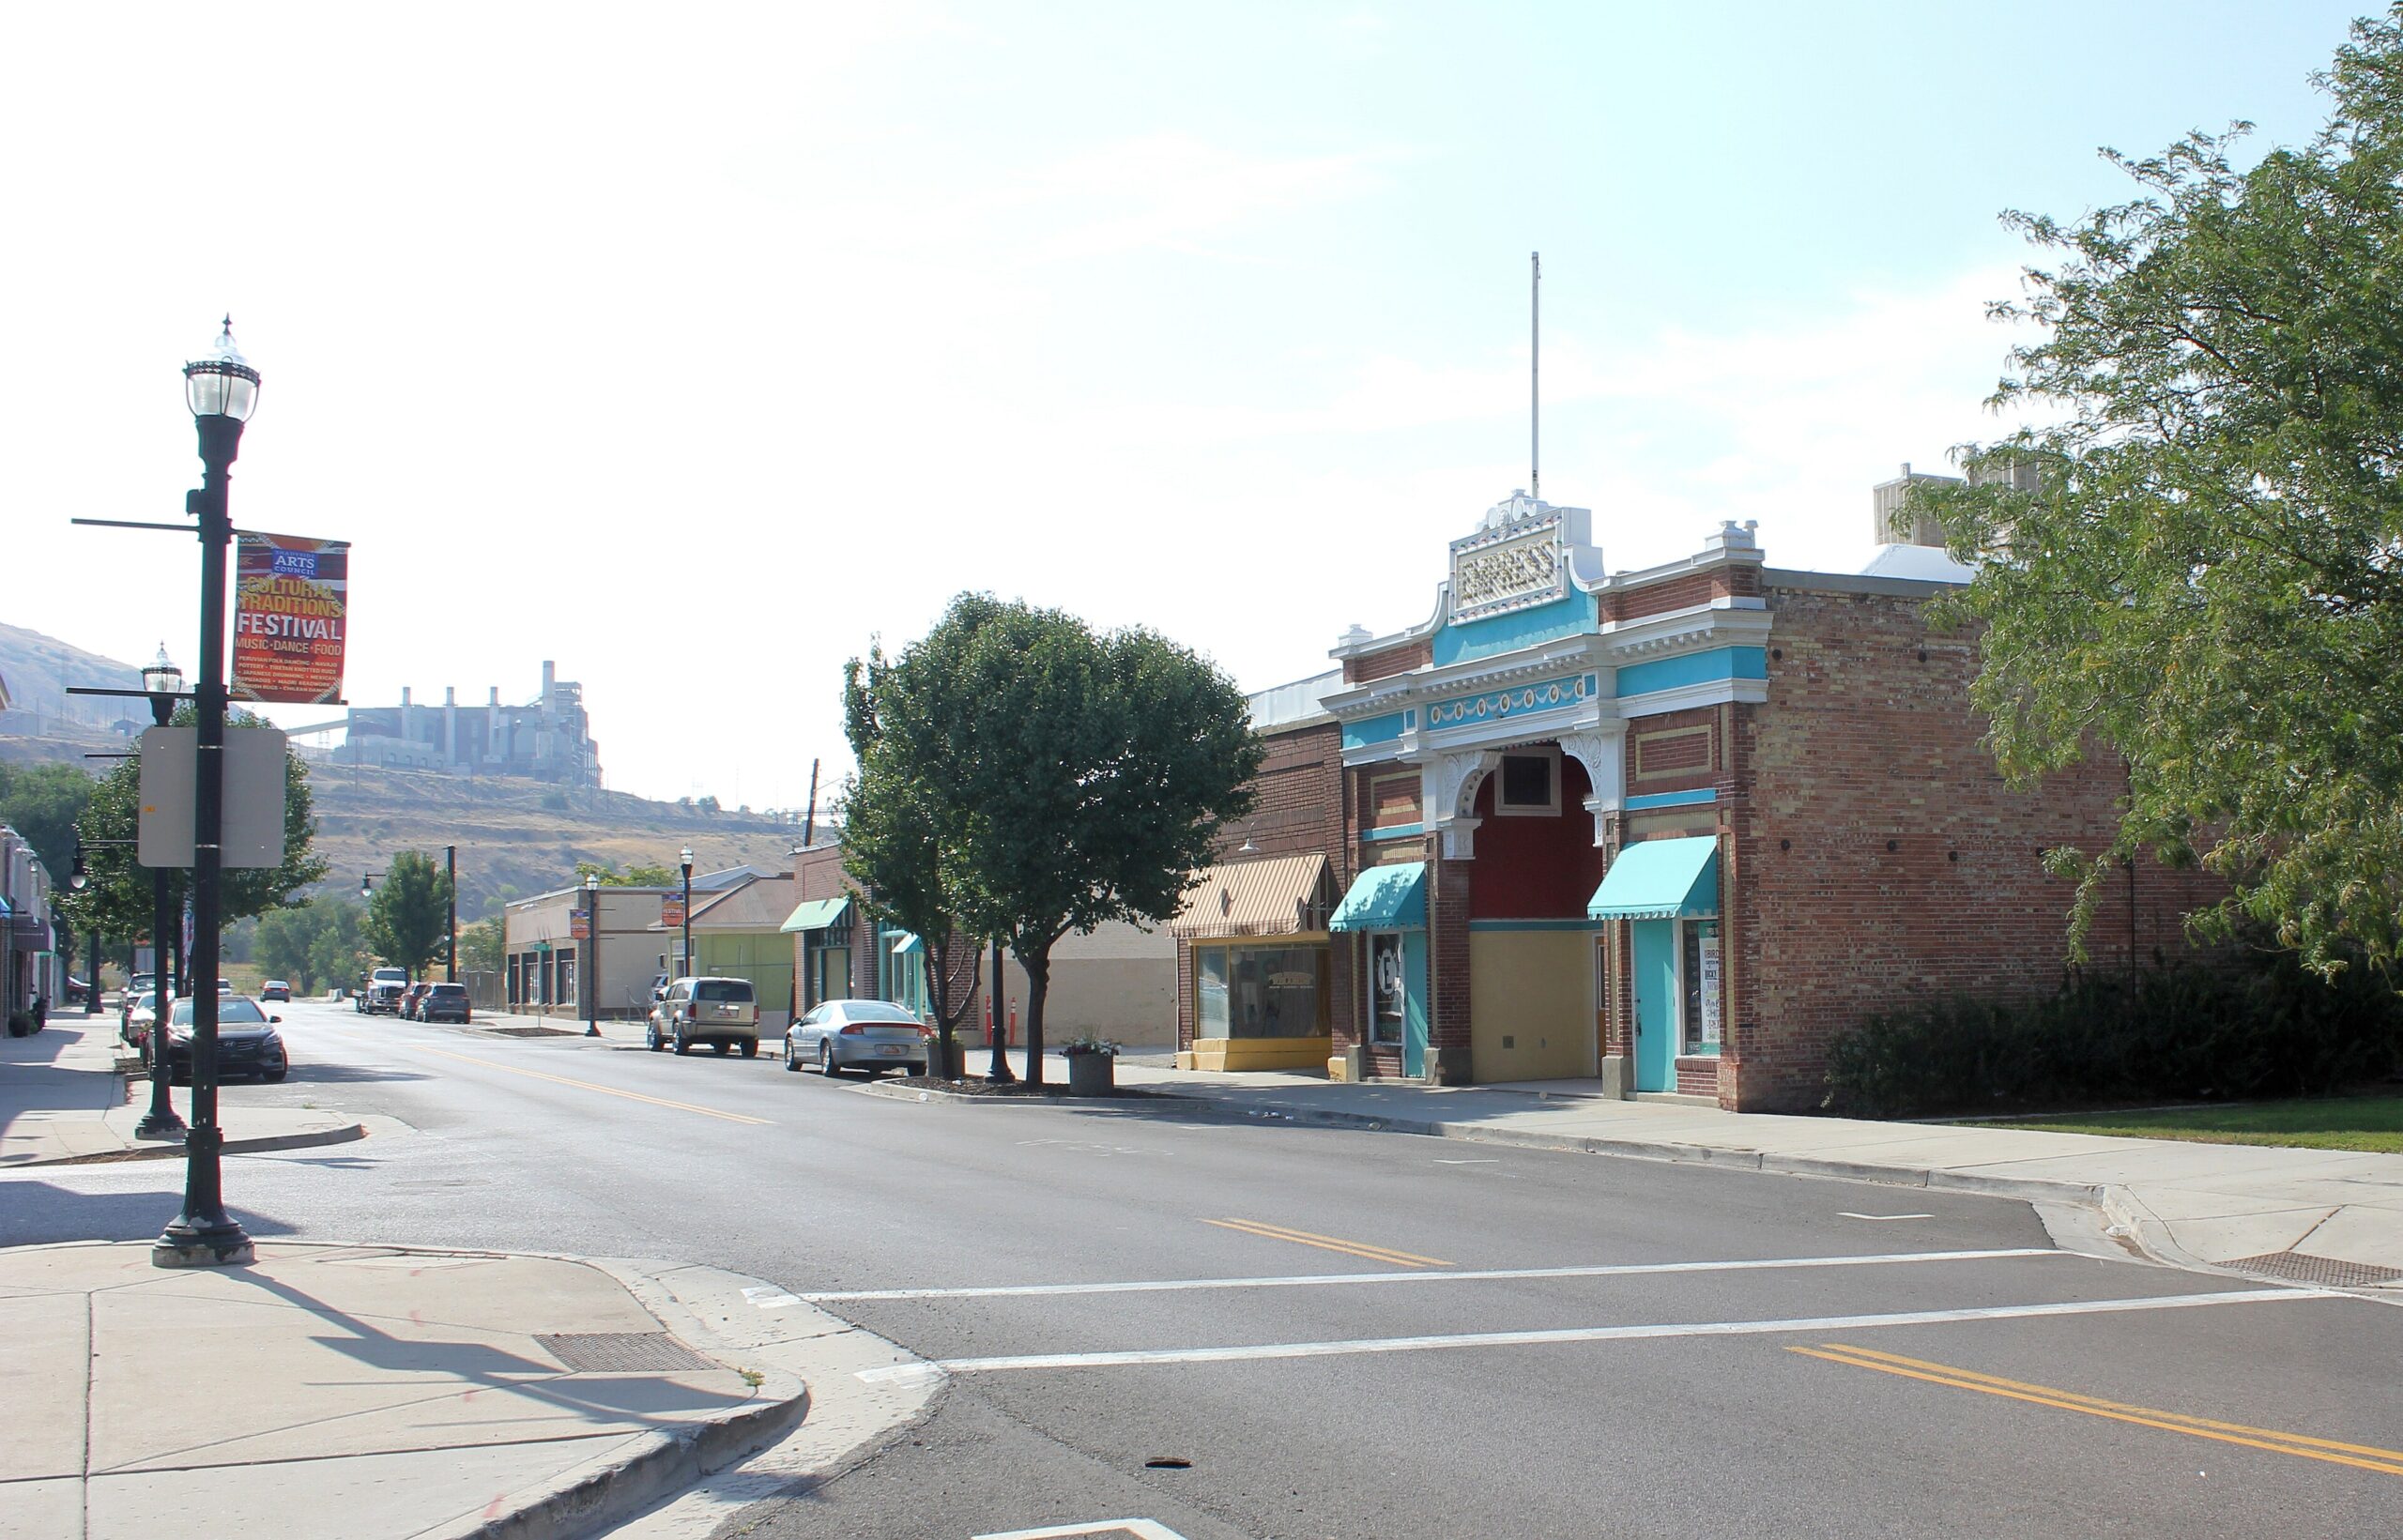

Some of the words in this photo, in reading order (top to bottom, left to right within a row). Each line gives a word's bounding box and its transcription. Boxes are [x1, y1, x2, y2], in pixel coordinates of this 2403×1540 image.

[274, 555, 315, 569] ARTS
[274, 566, 315, 575] COUNCIL
[1458, 540, 1554, 599] EMPRESS
[246, 576, 334, 601] CULTURAL
[239, 591, 343, 618] TRADITIONS
[237, 612, 342, 640] FESTIVAL
[273, 640, 309, 654] DANCE
[314, 644, 342, 656] FOOD
[1384, 956, 1392, 990] E
